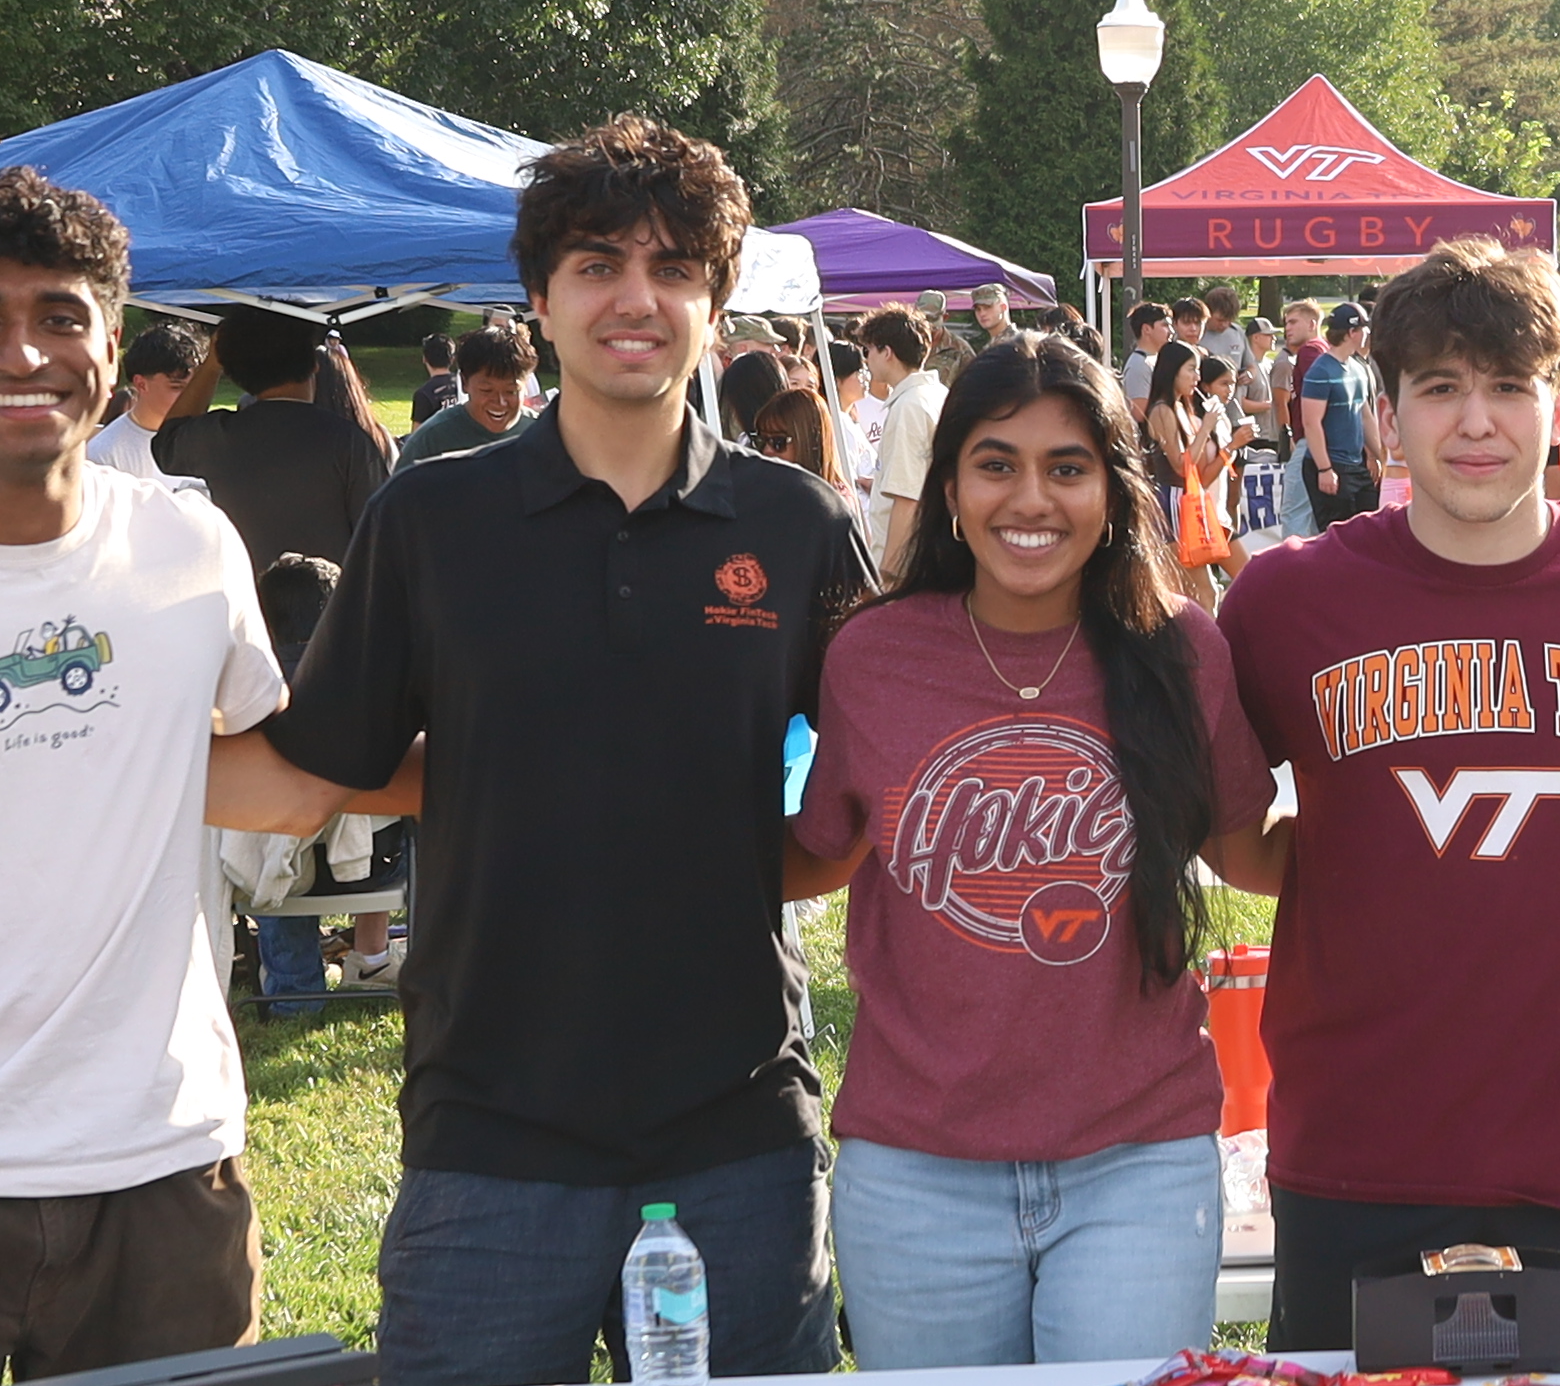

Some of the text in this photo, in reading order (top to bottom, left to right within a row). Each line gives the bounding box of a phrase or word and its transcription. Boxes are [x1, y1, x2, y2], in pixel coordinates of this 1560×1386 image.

[1245, 144, 1386, 182] VT
[1208, 216, 1434, 251] RUGBY
[1312, 639, 1536, 762] VIRGINIA
[4, 733, 30, 752] Life
[33, 732, 47, 744] is
[1030, 908, 1100, 943] VT
